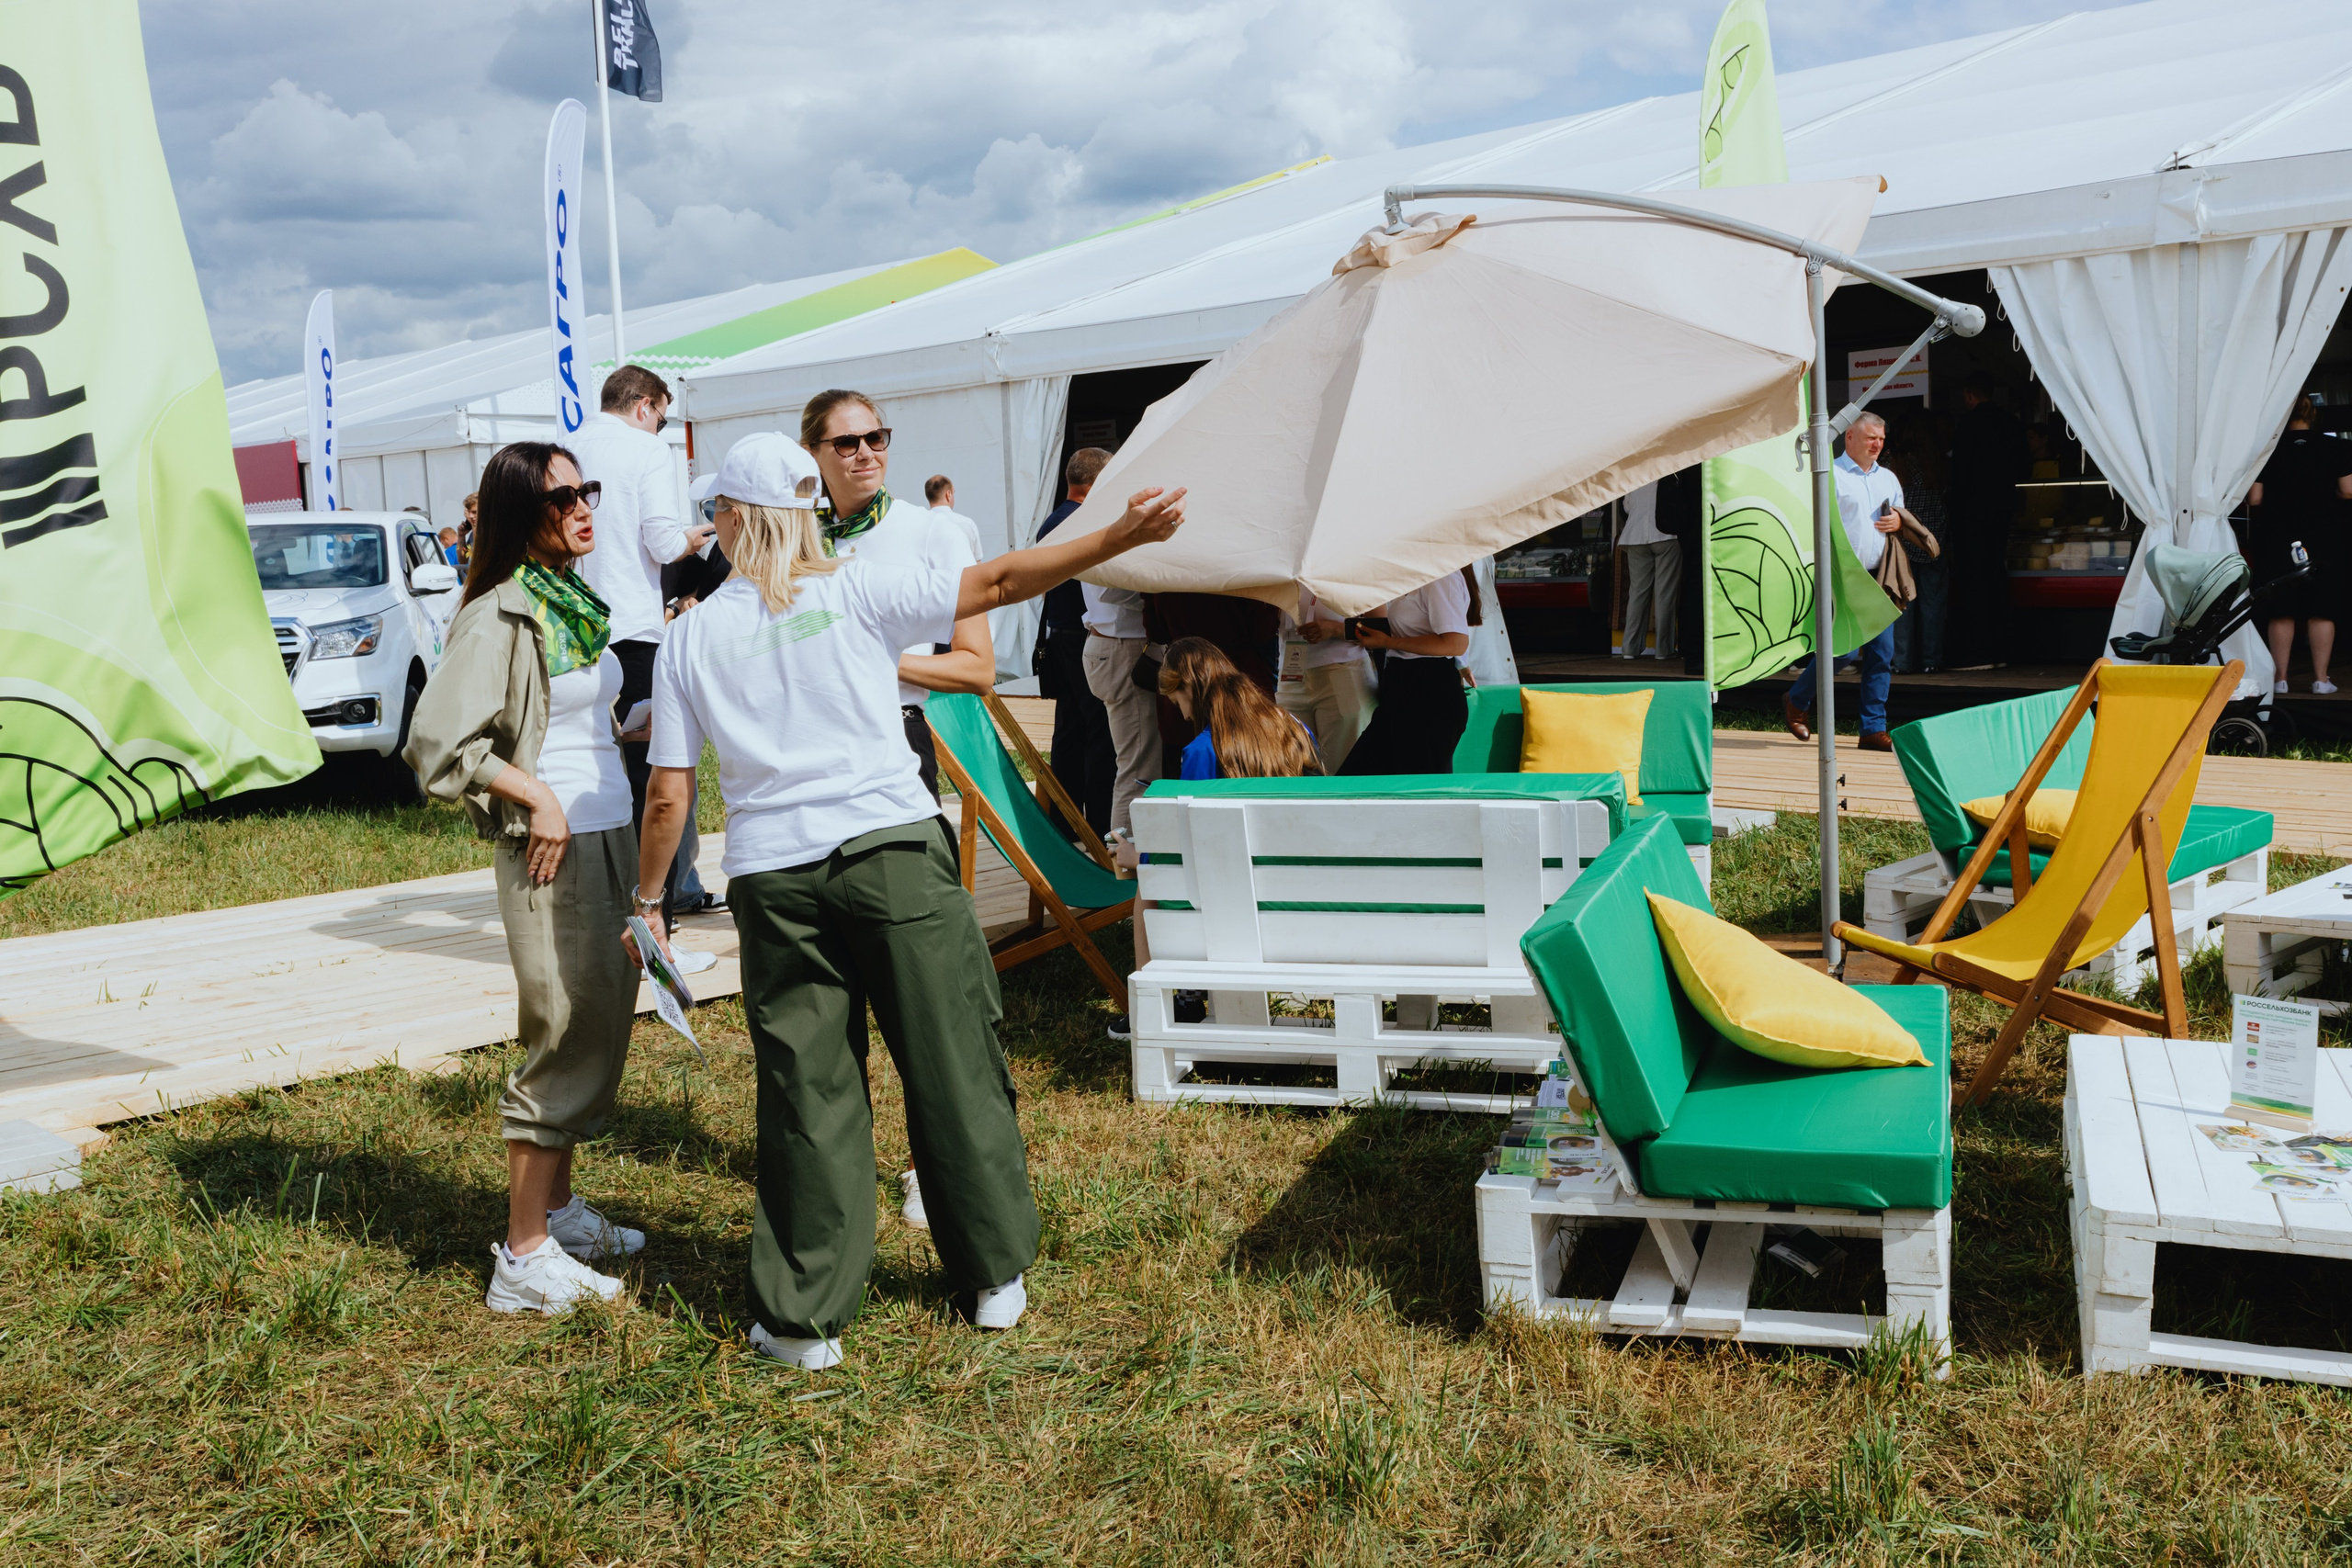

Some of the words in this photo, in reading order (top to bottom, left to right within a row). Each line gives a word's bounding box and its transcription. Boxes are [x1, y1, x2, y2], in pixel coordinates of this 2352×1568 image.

[1854, 359, 1877, 368] Ферма
[1894, 382, 1914, 390] область
[2246, 1000, 2312, 1017] РОССЕЛЬХОЗБАНК
